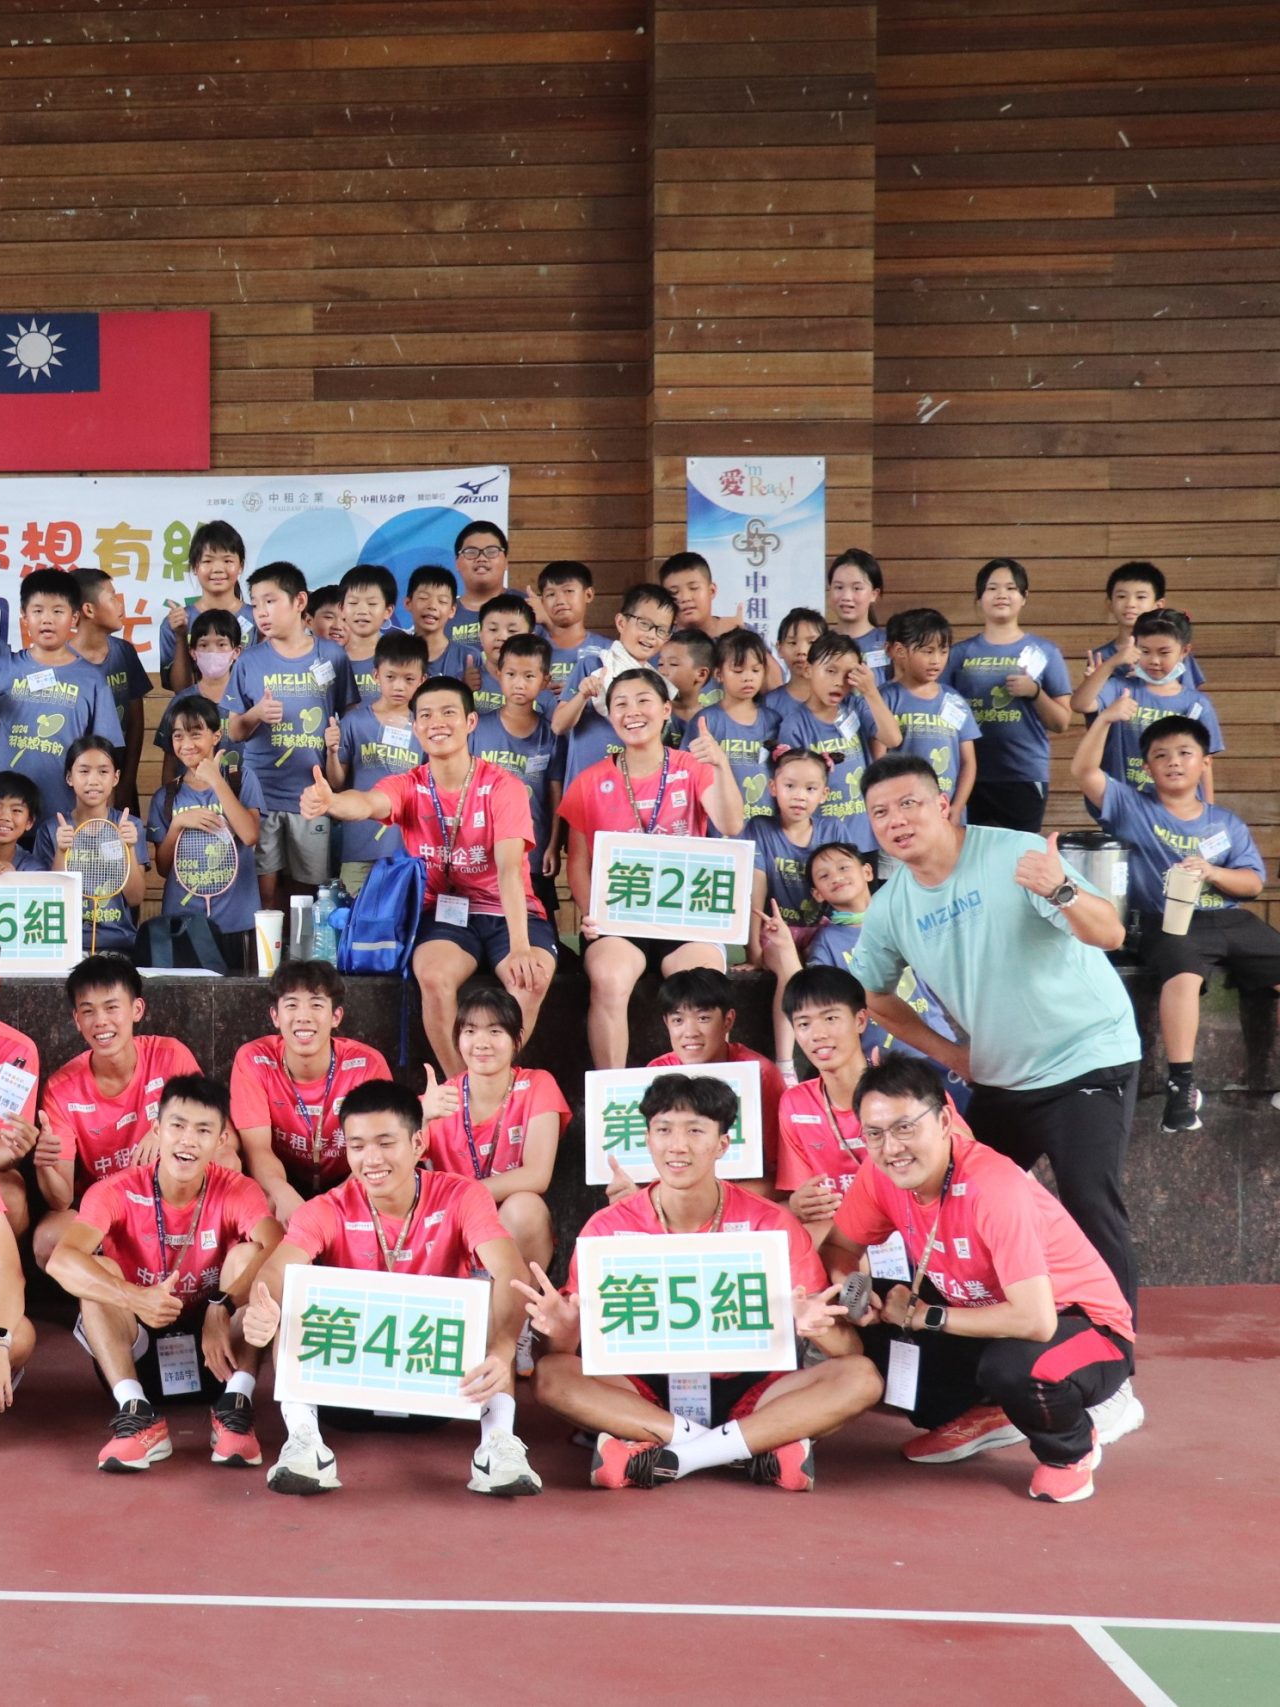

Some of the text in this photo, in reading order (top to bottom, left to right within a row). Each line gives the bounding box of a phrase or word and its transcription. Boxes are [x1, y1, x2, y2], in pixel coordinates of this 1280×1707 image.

[269, 492, 324, 504] 中租企業
[361, 493, 406, 504] 中租基金會
[453, 494, 499, 505] MIZUNO
[745, 571, 768, 640] 中租
[963, 656, 1018, 667] MIZUN
[263, 674, 316, 686] MIZUN
[271, 722, 293, 732] 2024
[361, 742, 419, 765] MIZUNO
[481, 749, 528, 767] MIZUN
[605, 861, 736, 915] 第2組
[916, 889, 982, 933] MIZUNO
[596, 1271, 775, 1336] 第5組
[297, 1303, 466, 1378] 第4組
